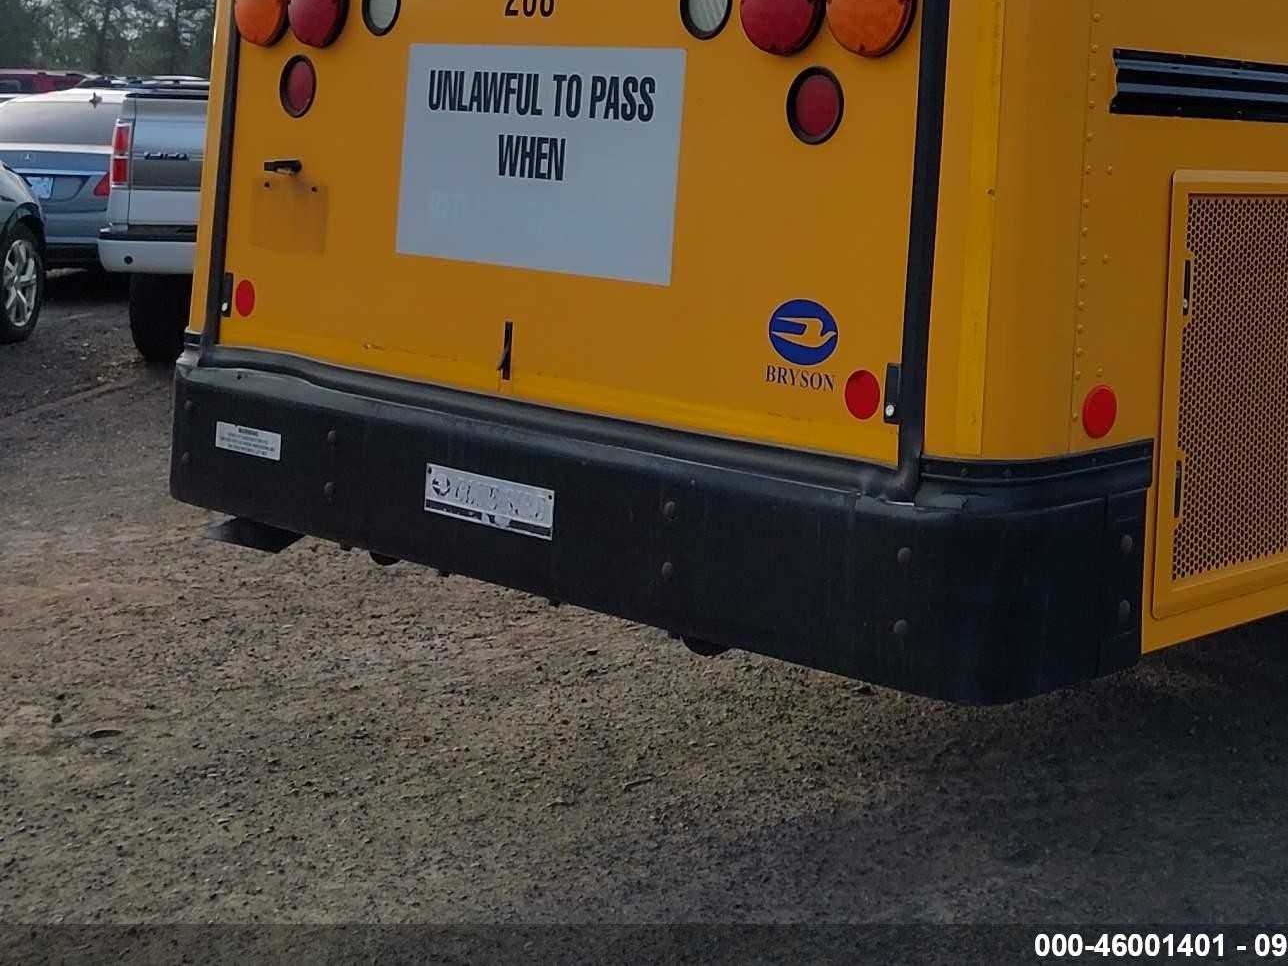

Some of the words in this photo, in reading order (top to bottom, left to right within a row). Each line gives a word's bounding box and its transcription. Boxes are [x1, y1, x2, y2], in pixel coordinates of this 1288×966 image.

[428, 69, 543, 117] UNLAWFUL
[552, 74, 582, 119] TO
[588, 75, 656, 123] PASS
[498, 133, 567, 181] WHEN
[766, 364, 836, 393] BRYSON
